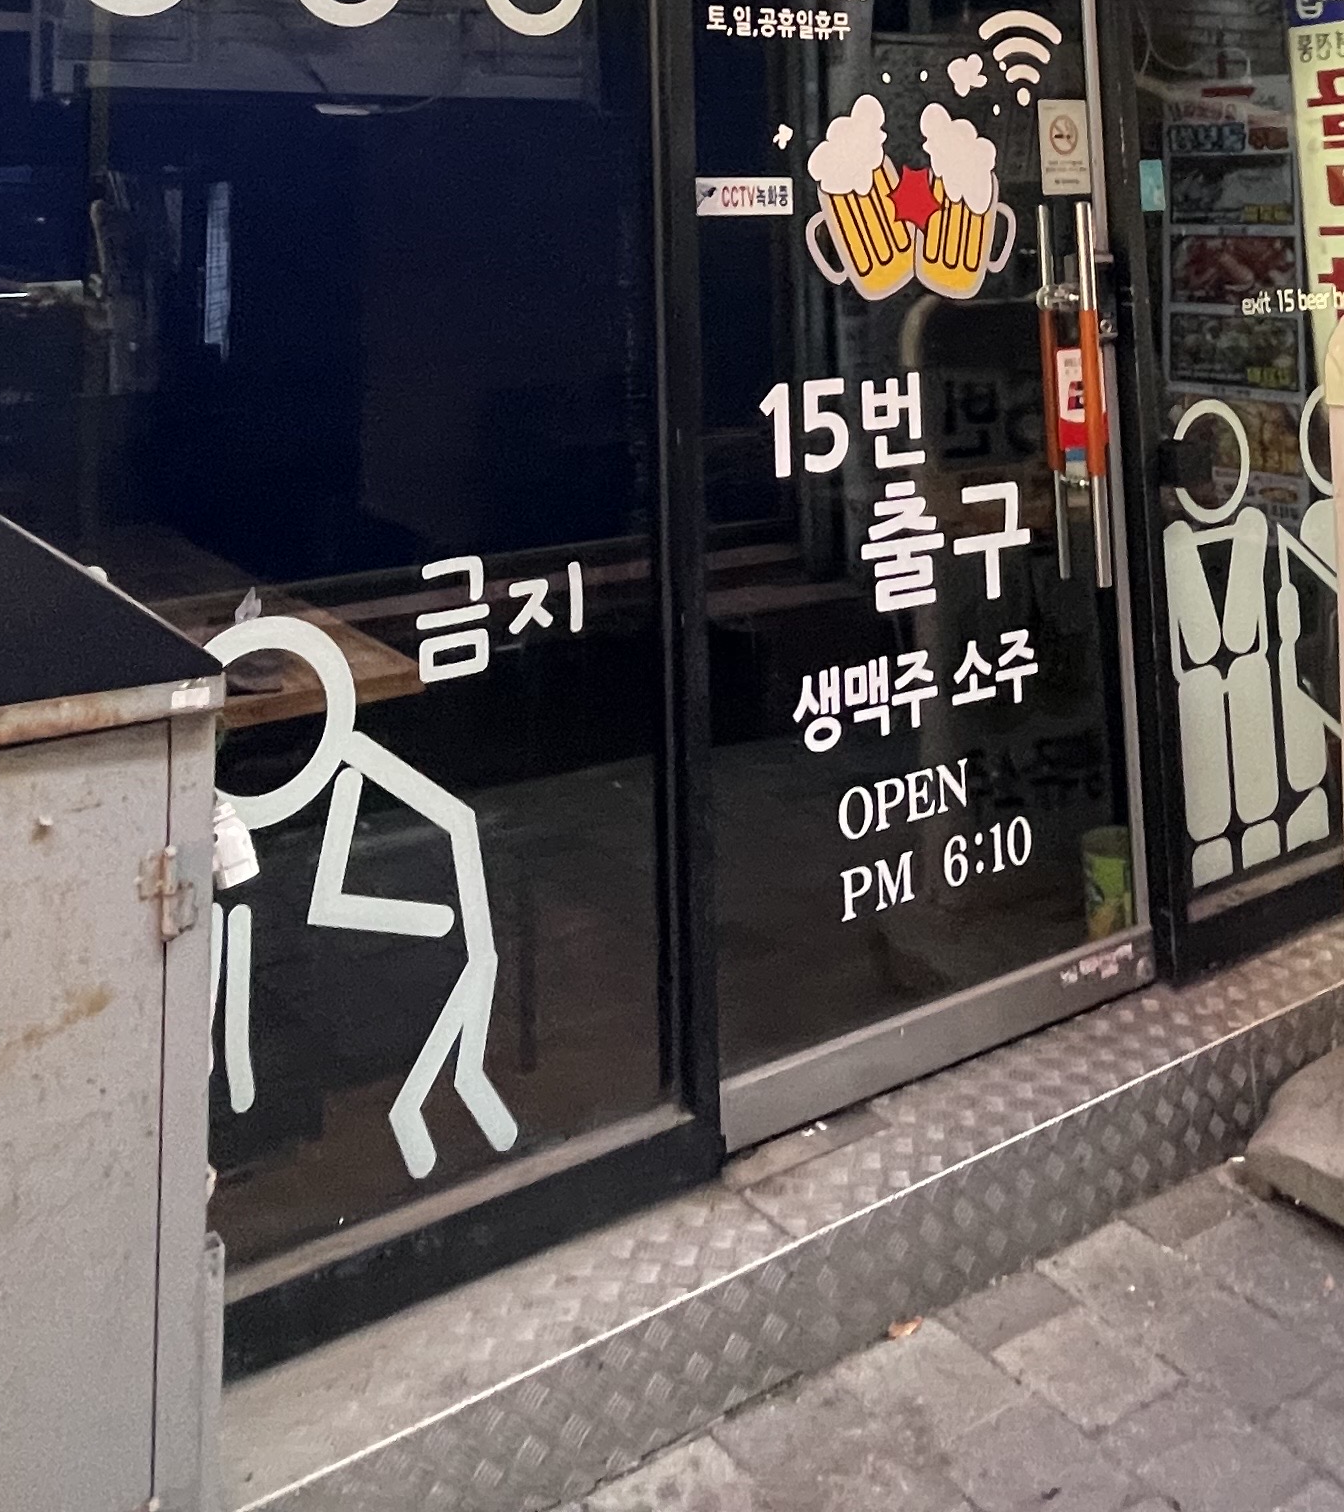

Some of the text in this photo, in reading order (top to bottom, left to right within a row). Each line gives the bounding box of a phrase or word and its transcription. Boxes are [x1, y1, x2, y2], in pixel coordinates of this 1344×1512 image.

[1241, 291, 1271, 316] exit
[1277, 288, 1295, 313] 15
[1298, 288, 1330, 311] beer
[758, 371, 926, 479] 15번
[860, 480, 1031, 612] 출구
[416, 555, 584, 684] 금지
[792, 628, 1038, 753] 생맥주 소주
[837, 758, 968, 840] OPEN
[840, 815, 1032, 922] PM 6:10
